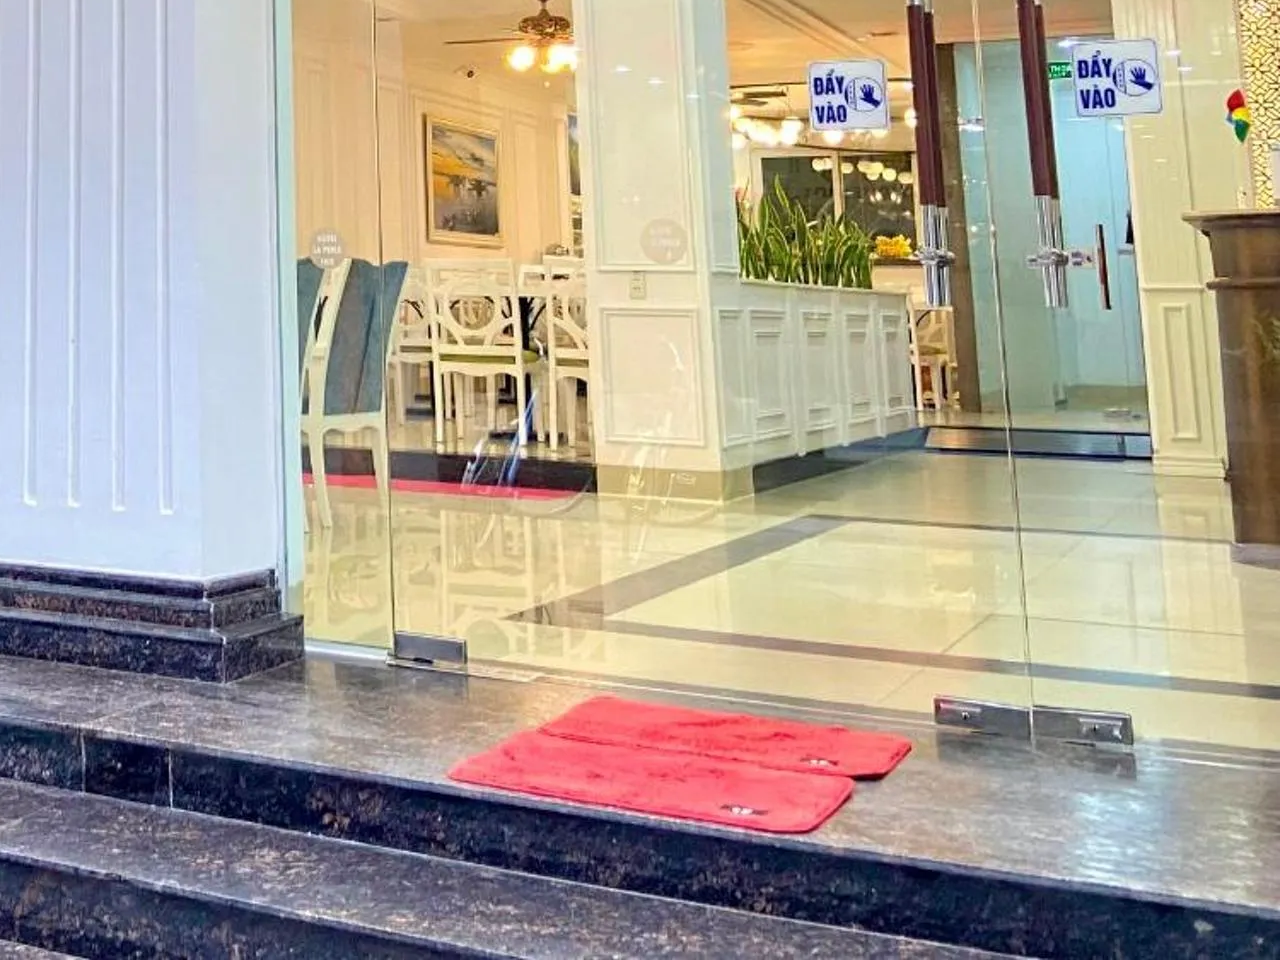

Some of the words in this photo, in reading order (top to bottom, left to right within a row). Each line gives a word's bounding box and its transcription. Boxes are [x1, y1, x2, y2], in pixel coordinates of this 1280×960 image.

[1077, 50, 1112, 78] ĐẨY
[813, 68, 844, 95] ĐẨY
[1079, 84, 1116, 109] VÀO
[815, 101, 847, 124] VÀO
